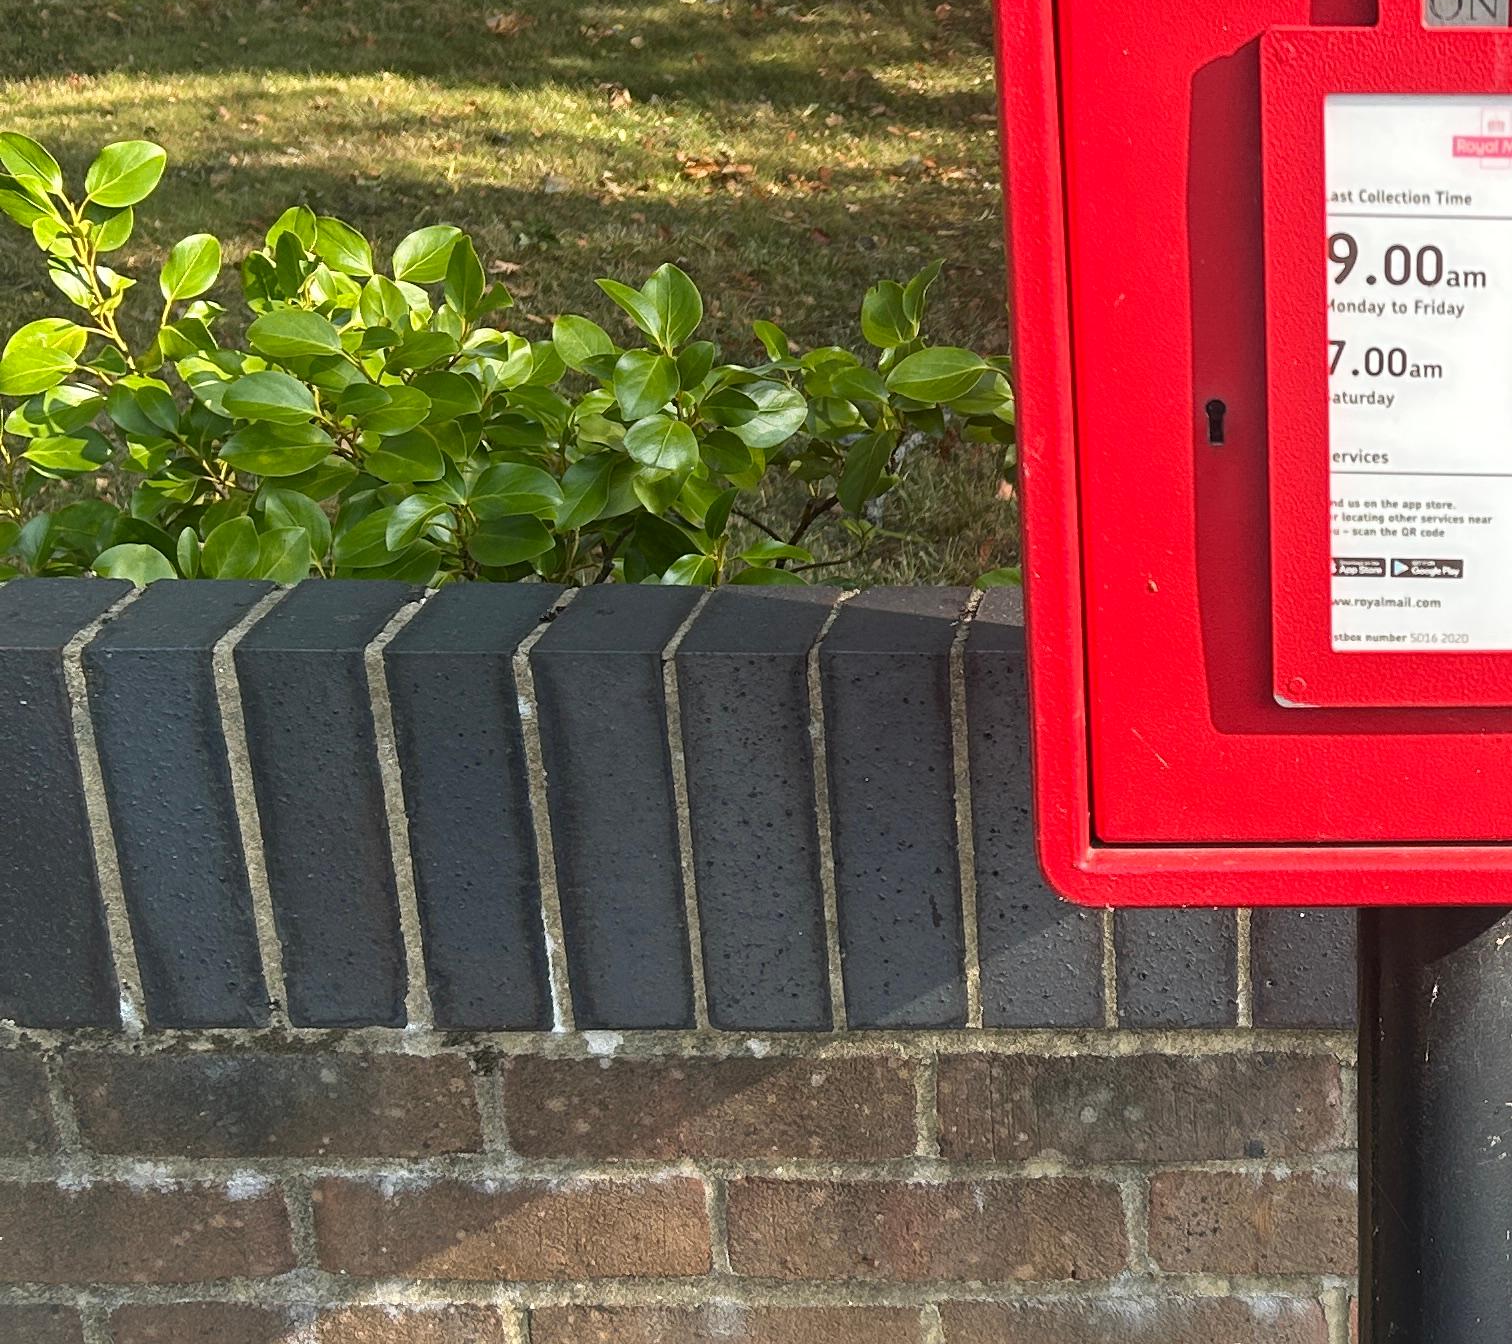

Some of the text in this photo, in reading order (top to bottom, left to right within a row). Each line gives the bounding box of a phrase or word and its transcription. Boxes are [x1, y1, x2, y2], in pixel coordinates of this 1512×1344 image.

[1456, 138, 1498, 155] Royal
[1327, 188, 1472, 206] ast Collection Time
[1328, 232, 1487, 287] 9.00am
[1392, 301, 1407, 314] to
[1414, 299, 1465, 319] Friday
[1328, 340, 1443, 378] 7.00am
[1331, 391, 1395, 408] aturday
[1331, 449, 1389, 463] ervices
[1331, 498, 1344, 508] nd
[1364, 501, 1377, 509] on
[1381, 499, 1398, 509] the
[1402, 501, 1422, 511] app
[1342, 513, 1385, 525] locating
[1388, 514, 1417, 523] other
[1421, 514, 1465, 524] services
[1468, 515, 1493, 525] near
[1352, 527, 1377, 536] scan
[1380, 527, 1398, 537] the
[1401, 527, 1417, 537] QR
[1420, 528, 1445, 538] code
[1332, 597, 1441, 609] ww.royalmail.com
[1334, 633, 1361, 642] stbox
[1365, 633, 1408, 642] number
